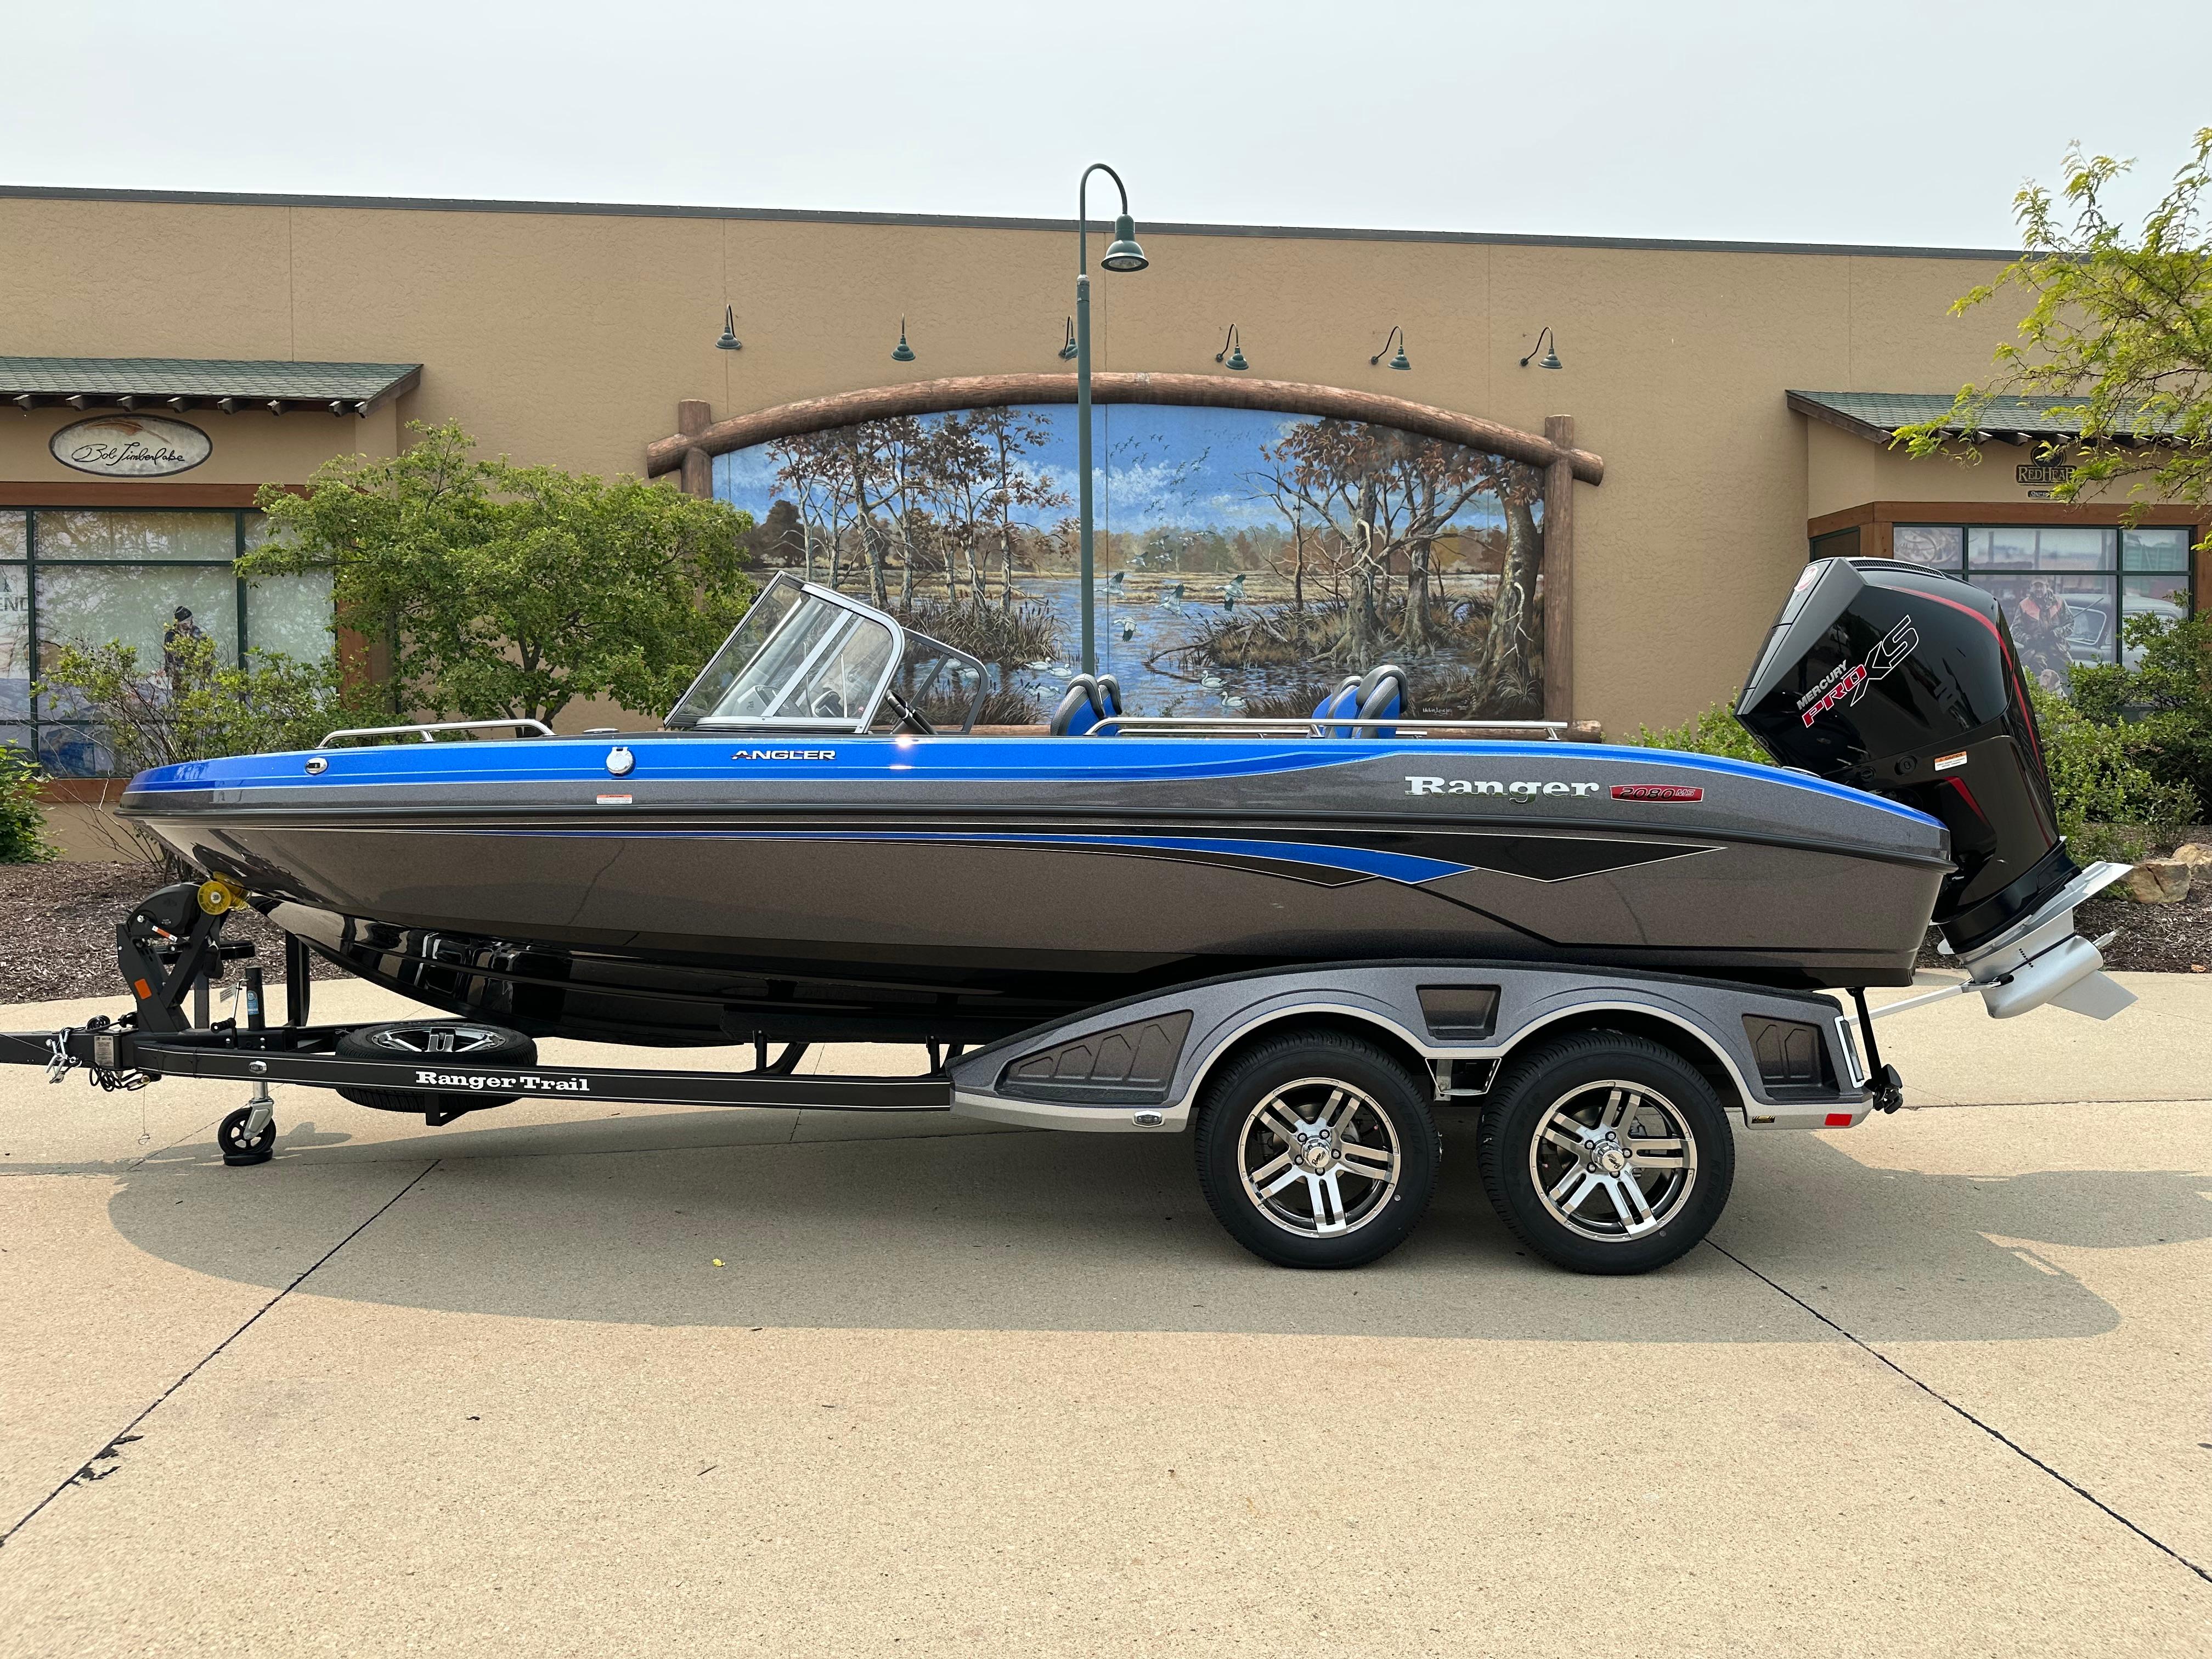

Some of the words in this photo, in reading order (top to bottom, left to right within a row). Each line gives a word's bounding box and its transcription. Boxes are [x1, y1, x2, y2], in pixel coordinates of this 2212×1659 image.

[71, 443, 117, 462] Bob
[105, 442, 185, 466] Timberlake
[1796, 659, 1848, 710] MERCURY
[731, 750, 837, 760] ANGLER
[1404, 775, 1600, 805] Ranger
[415, 1070, 517, 1090] Ranger
[520, 1075, 591, 1092] Trail
